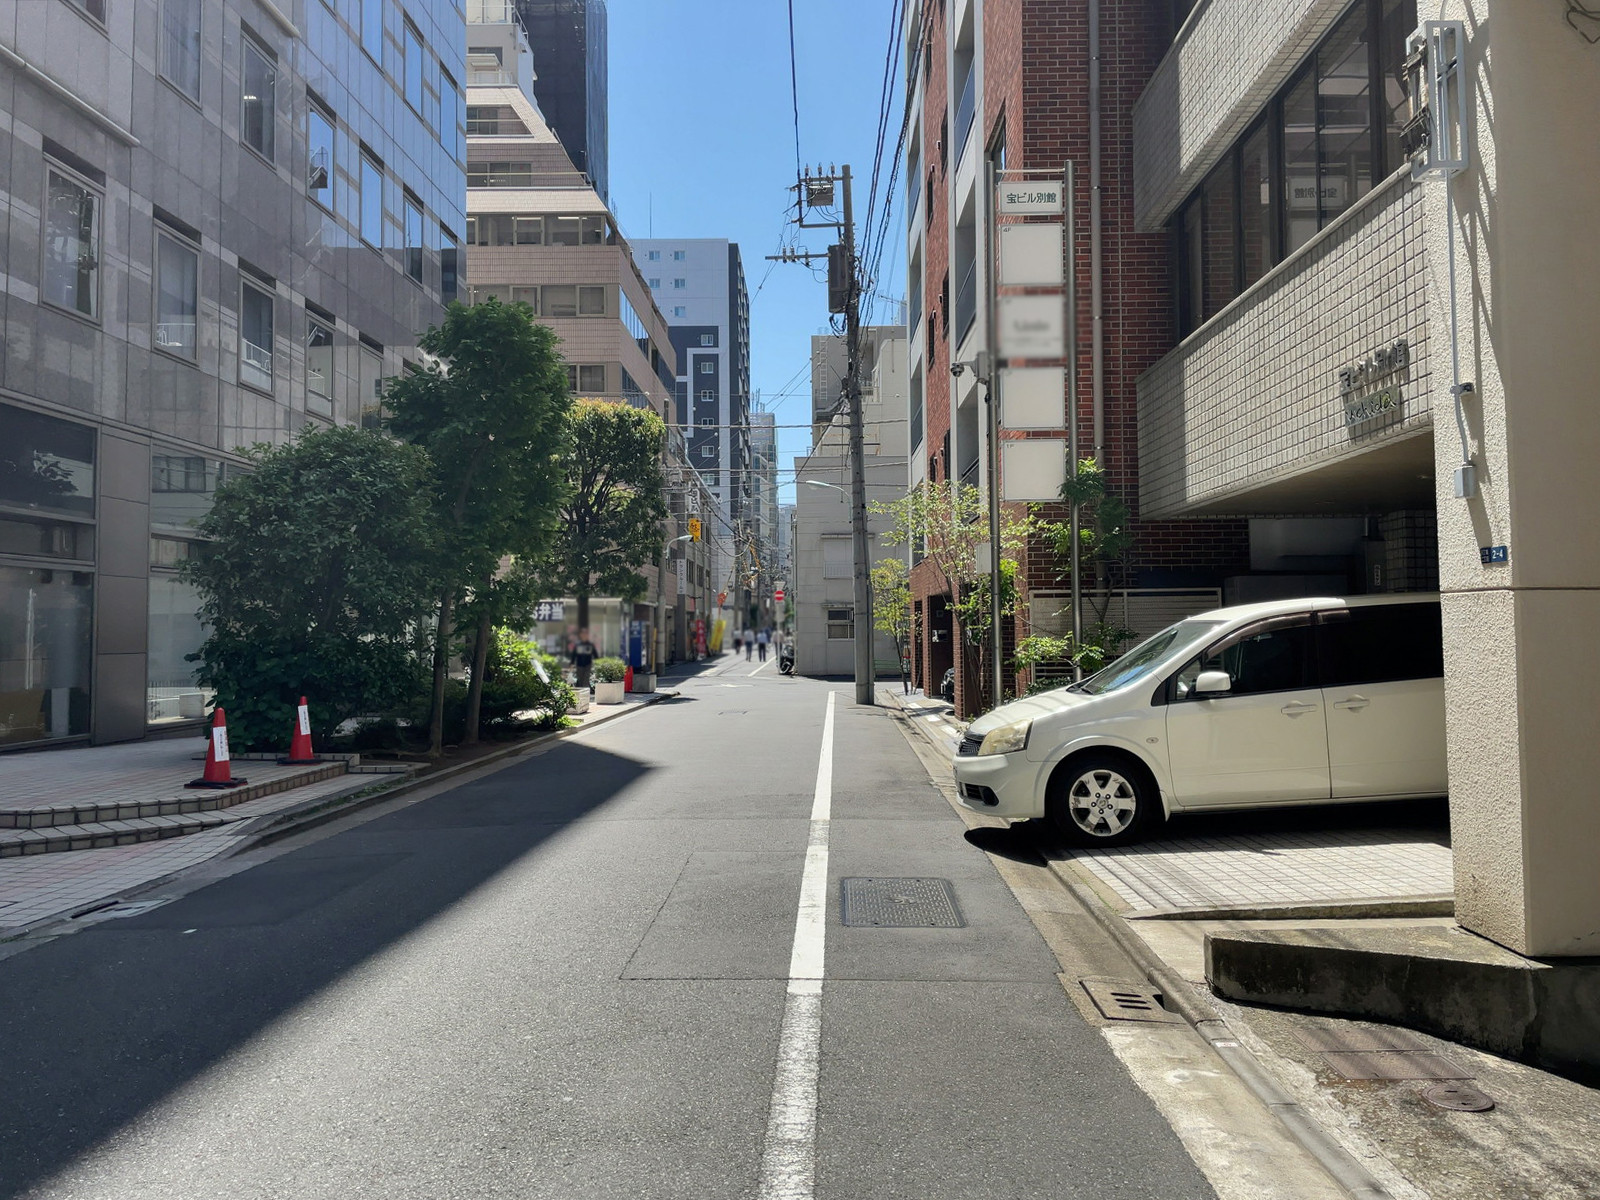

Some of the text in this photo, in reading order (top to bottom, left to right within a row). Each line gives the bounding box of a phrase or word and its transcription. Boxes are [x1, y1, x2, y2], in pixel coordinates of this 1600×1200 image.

[1006, 192, 1057, 204] 宝ビル別館
